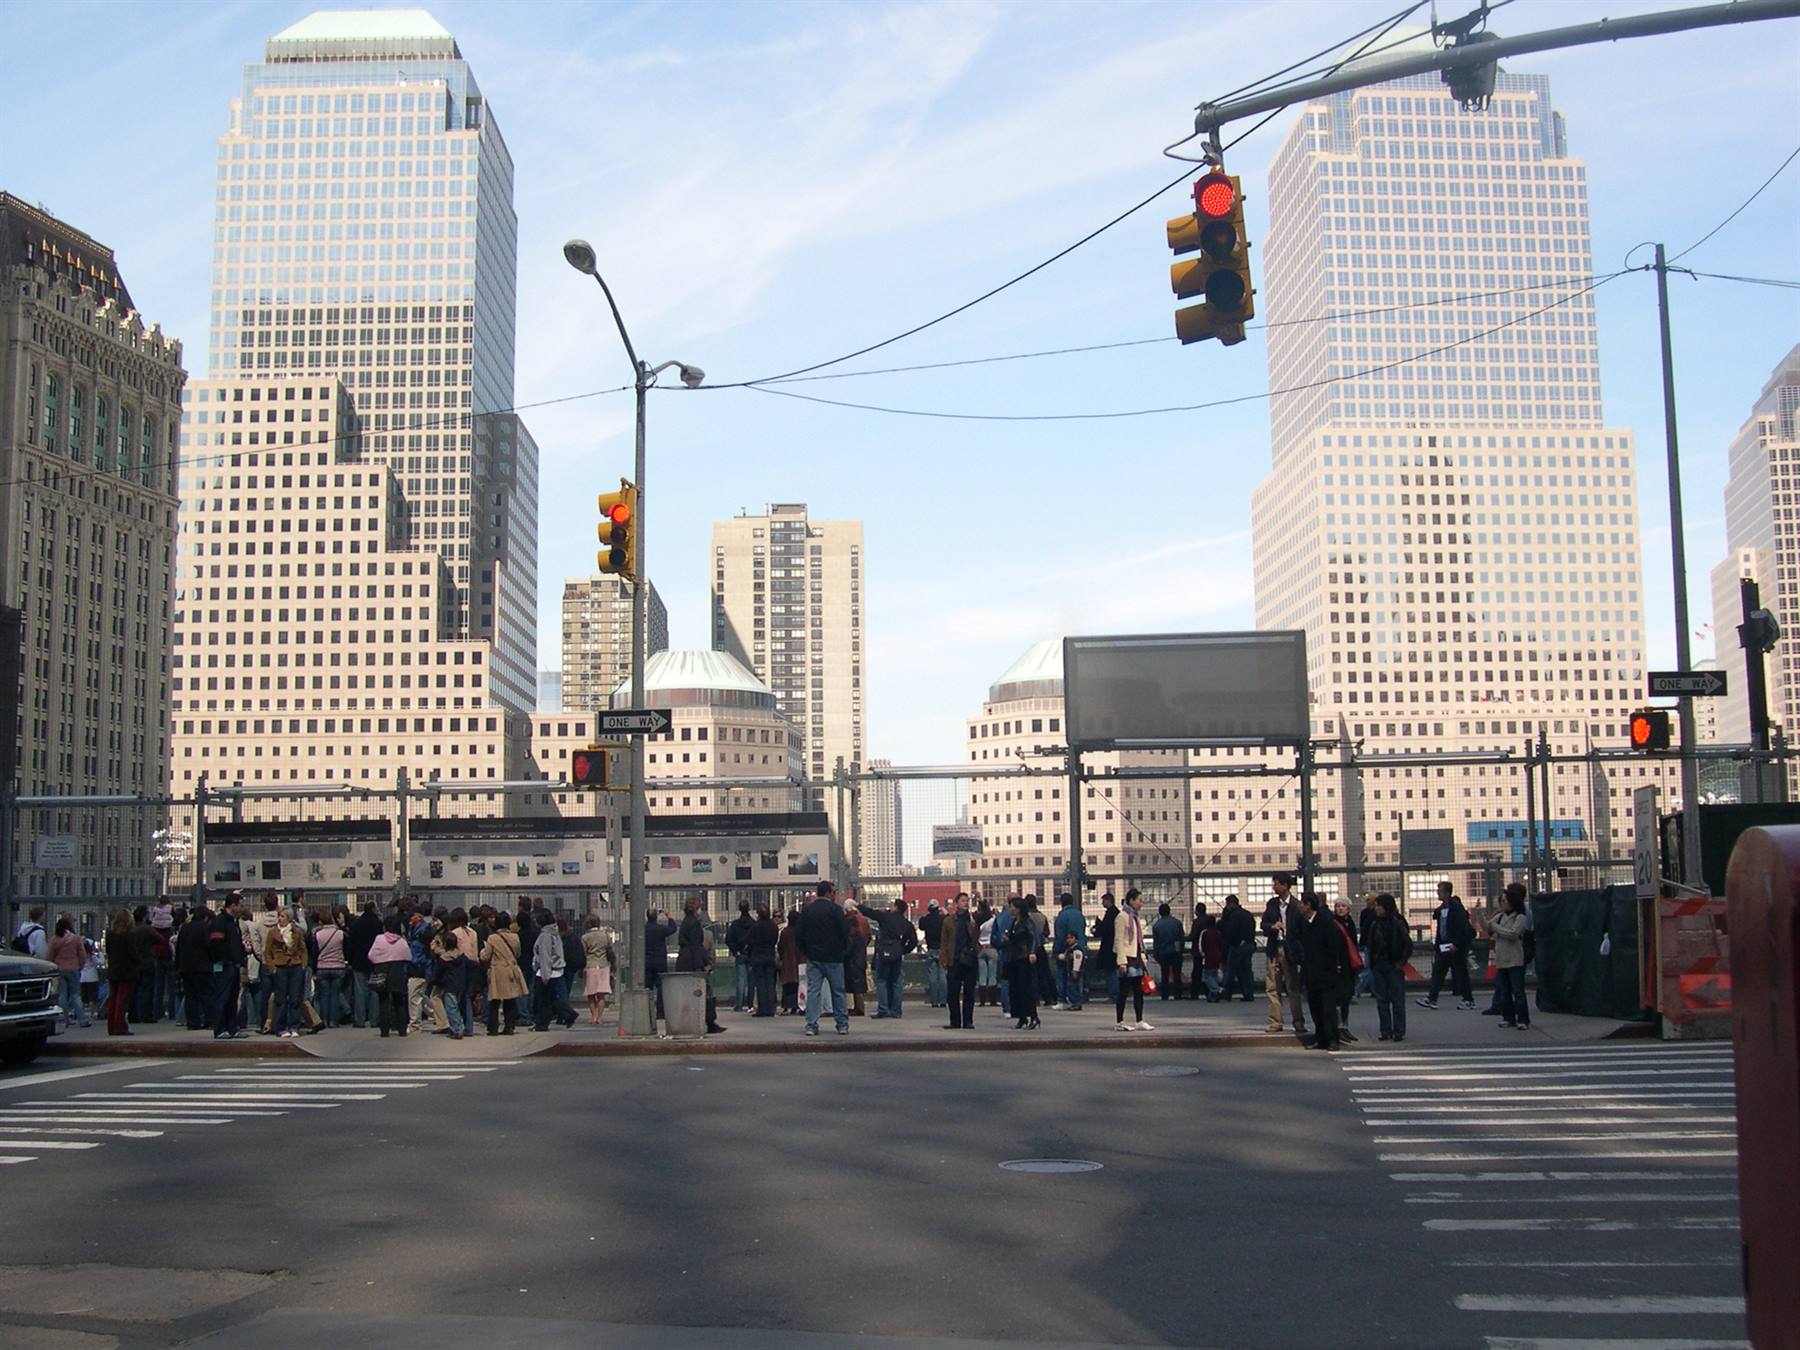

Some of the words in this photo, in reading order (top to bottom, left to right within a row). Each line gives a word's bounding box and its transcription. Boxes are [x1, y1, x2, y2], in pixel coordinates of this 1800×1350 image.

[1660, 679, 1681, 689] ONE
[1691, 678, 1714, 689] WAY
[608, 717, 630, 728] ONE
[639, 716, 661, 727] WAY
[1638, 850, 1652, 885] 20
